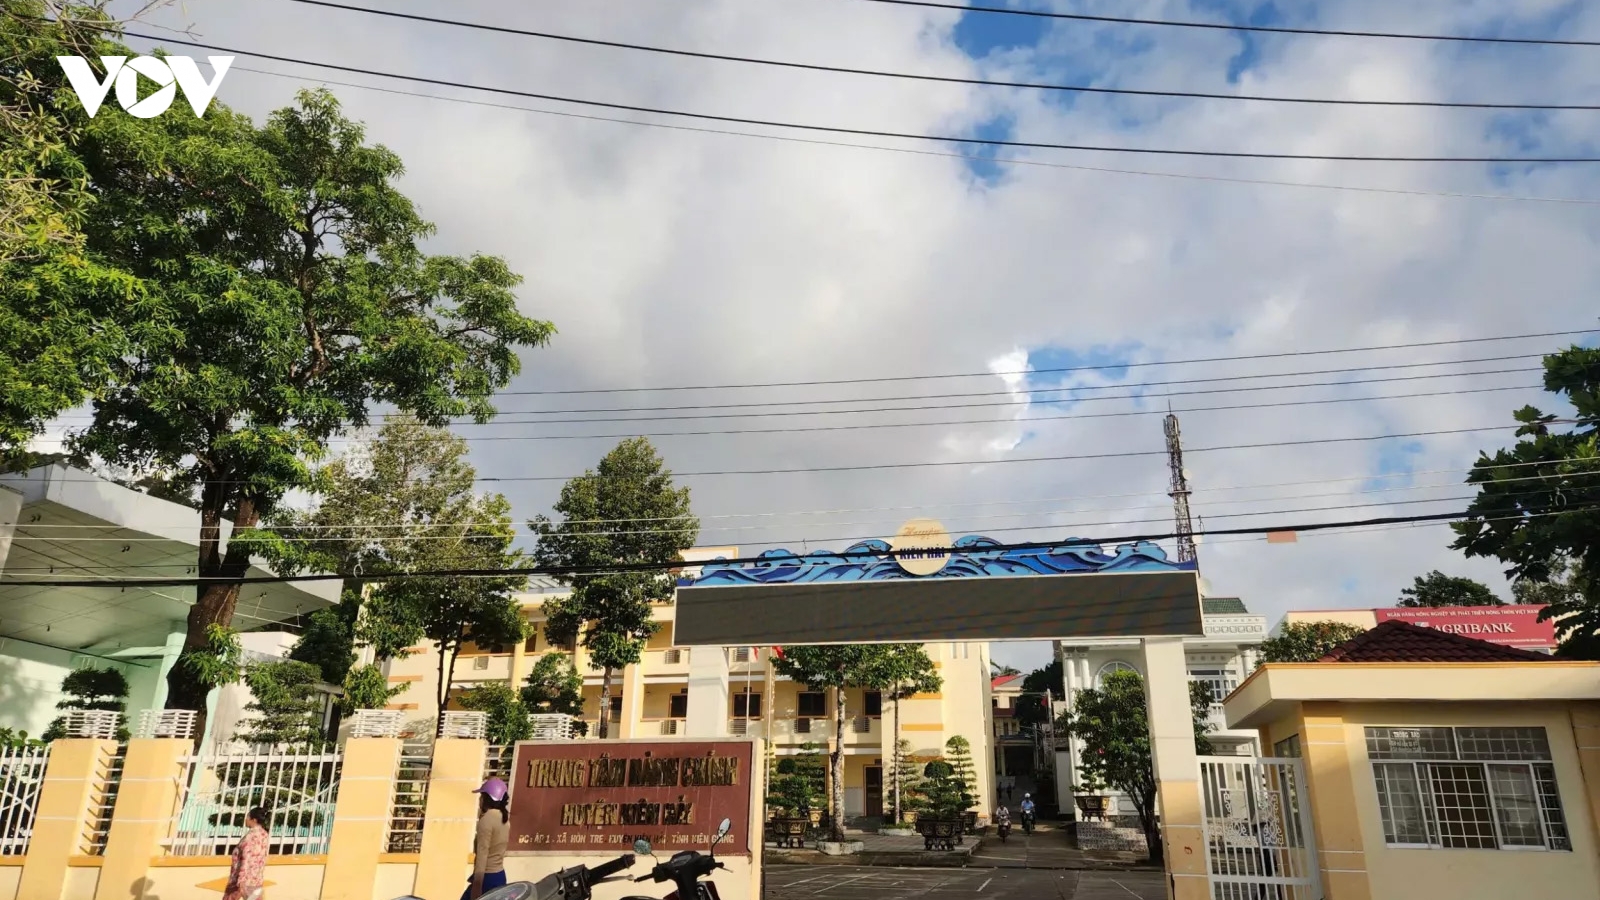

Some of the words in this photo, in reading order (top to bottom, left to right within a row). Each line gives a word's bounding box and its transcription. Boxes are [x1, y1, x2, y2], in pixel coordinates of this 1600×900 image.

[1433, 622, 1515, 634] AGRIBANK
[528, 758, 585, 788] TRUNG
[588, 752, 627, 788] TÂM
[681, 749, 739, 788] CHÍNH
[561, 798, 620, 830] HUYỆN
